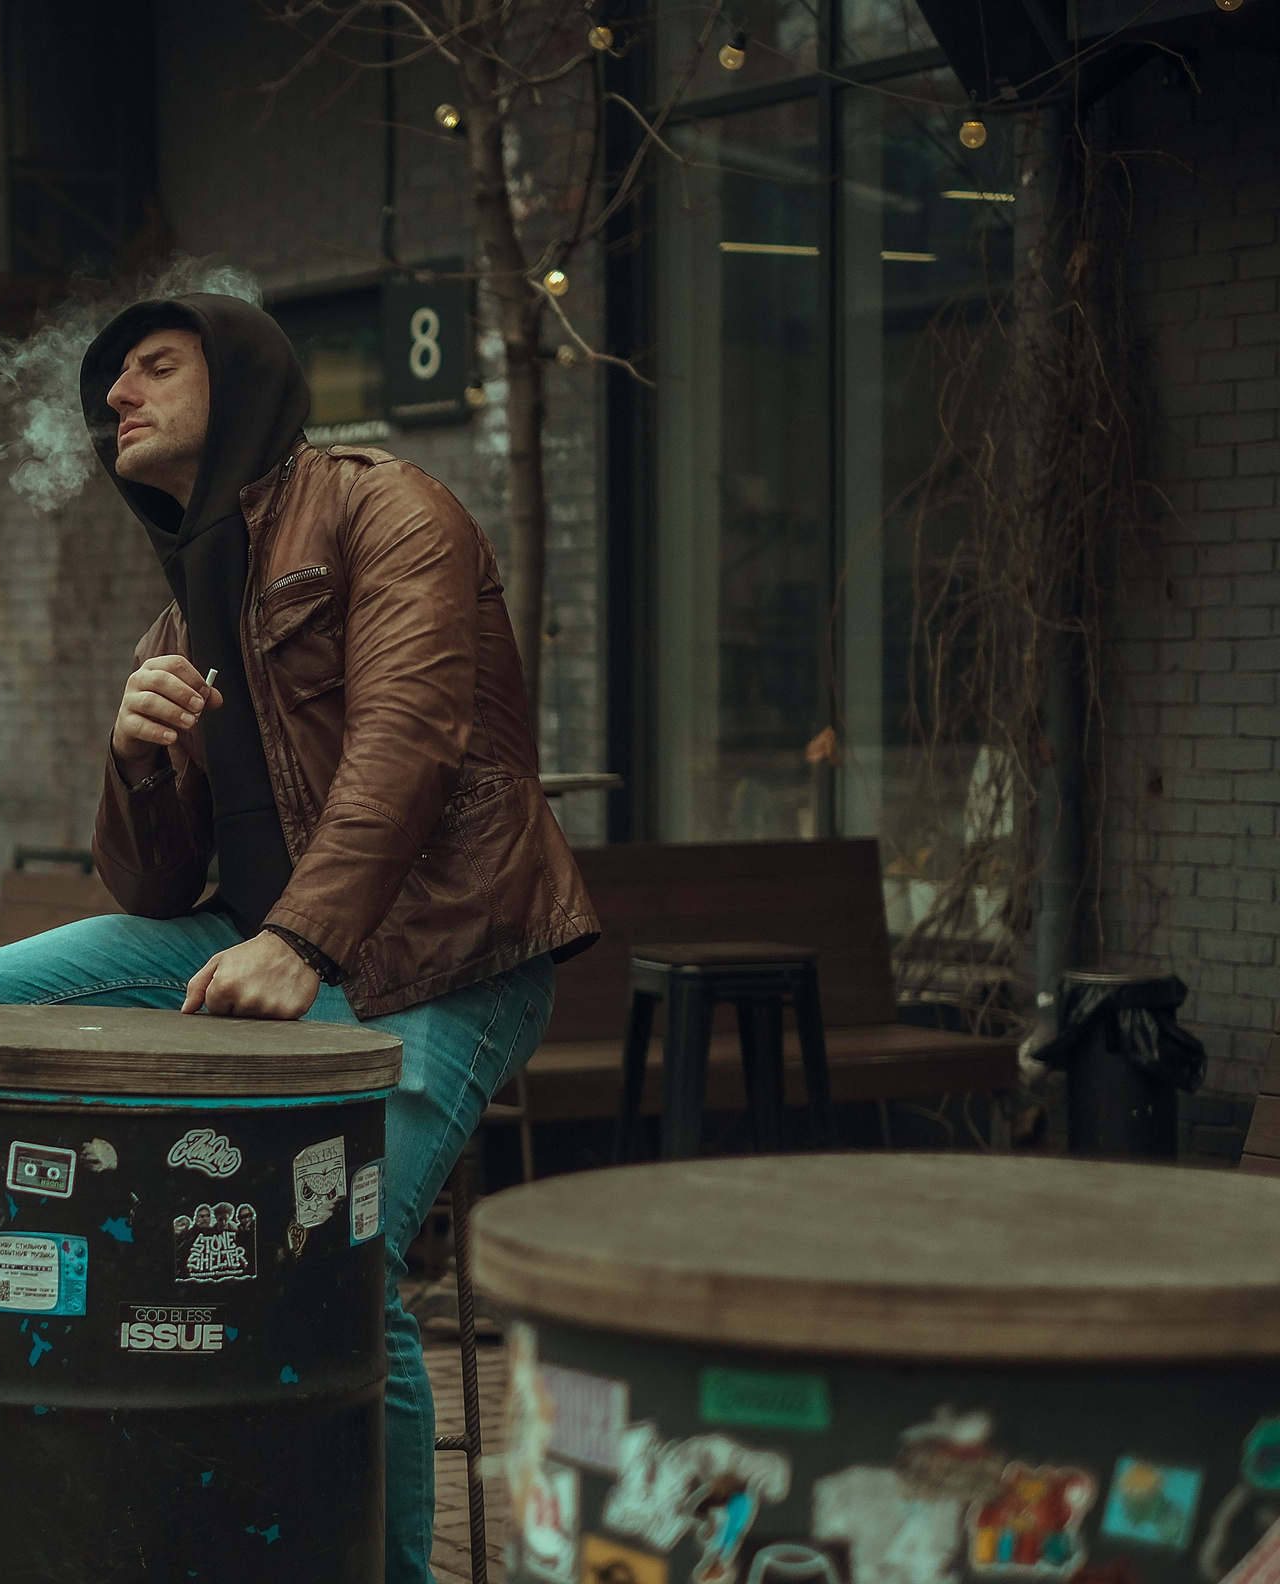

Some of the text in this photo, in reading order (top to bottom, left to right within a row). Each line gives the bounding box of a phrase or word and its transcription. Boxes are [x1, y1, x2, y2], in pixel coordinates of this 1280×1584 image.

[410, 307, 441, 380] 8
[15, 1242, 47, 1250] СТИЛЬНУЮ
[190, 1231, 237, 1253] STONE
[30, 1251, 55, 1259] МУЗЫКУ
[187, 1247, 248, 1271] SHELTER
[135, 1309, 212, 1322] GOD BLESS
[120, 1322, 223, 1350] ISSUE
